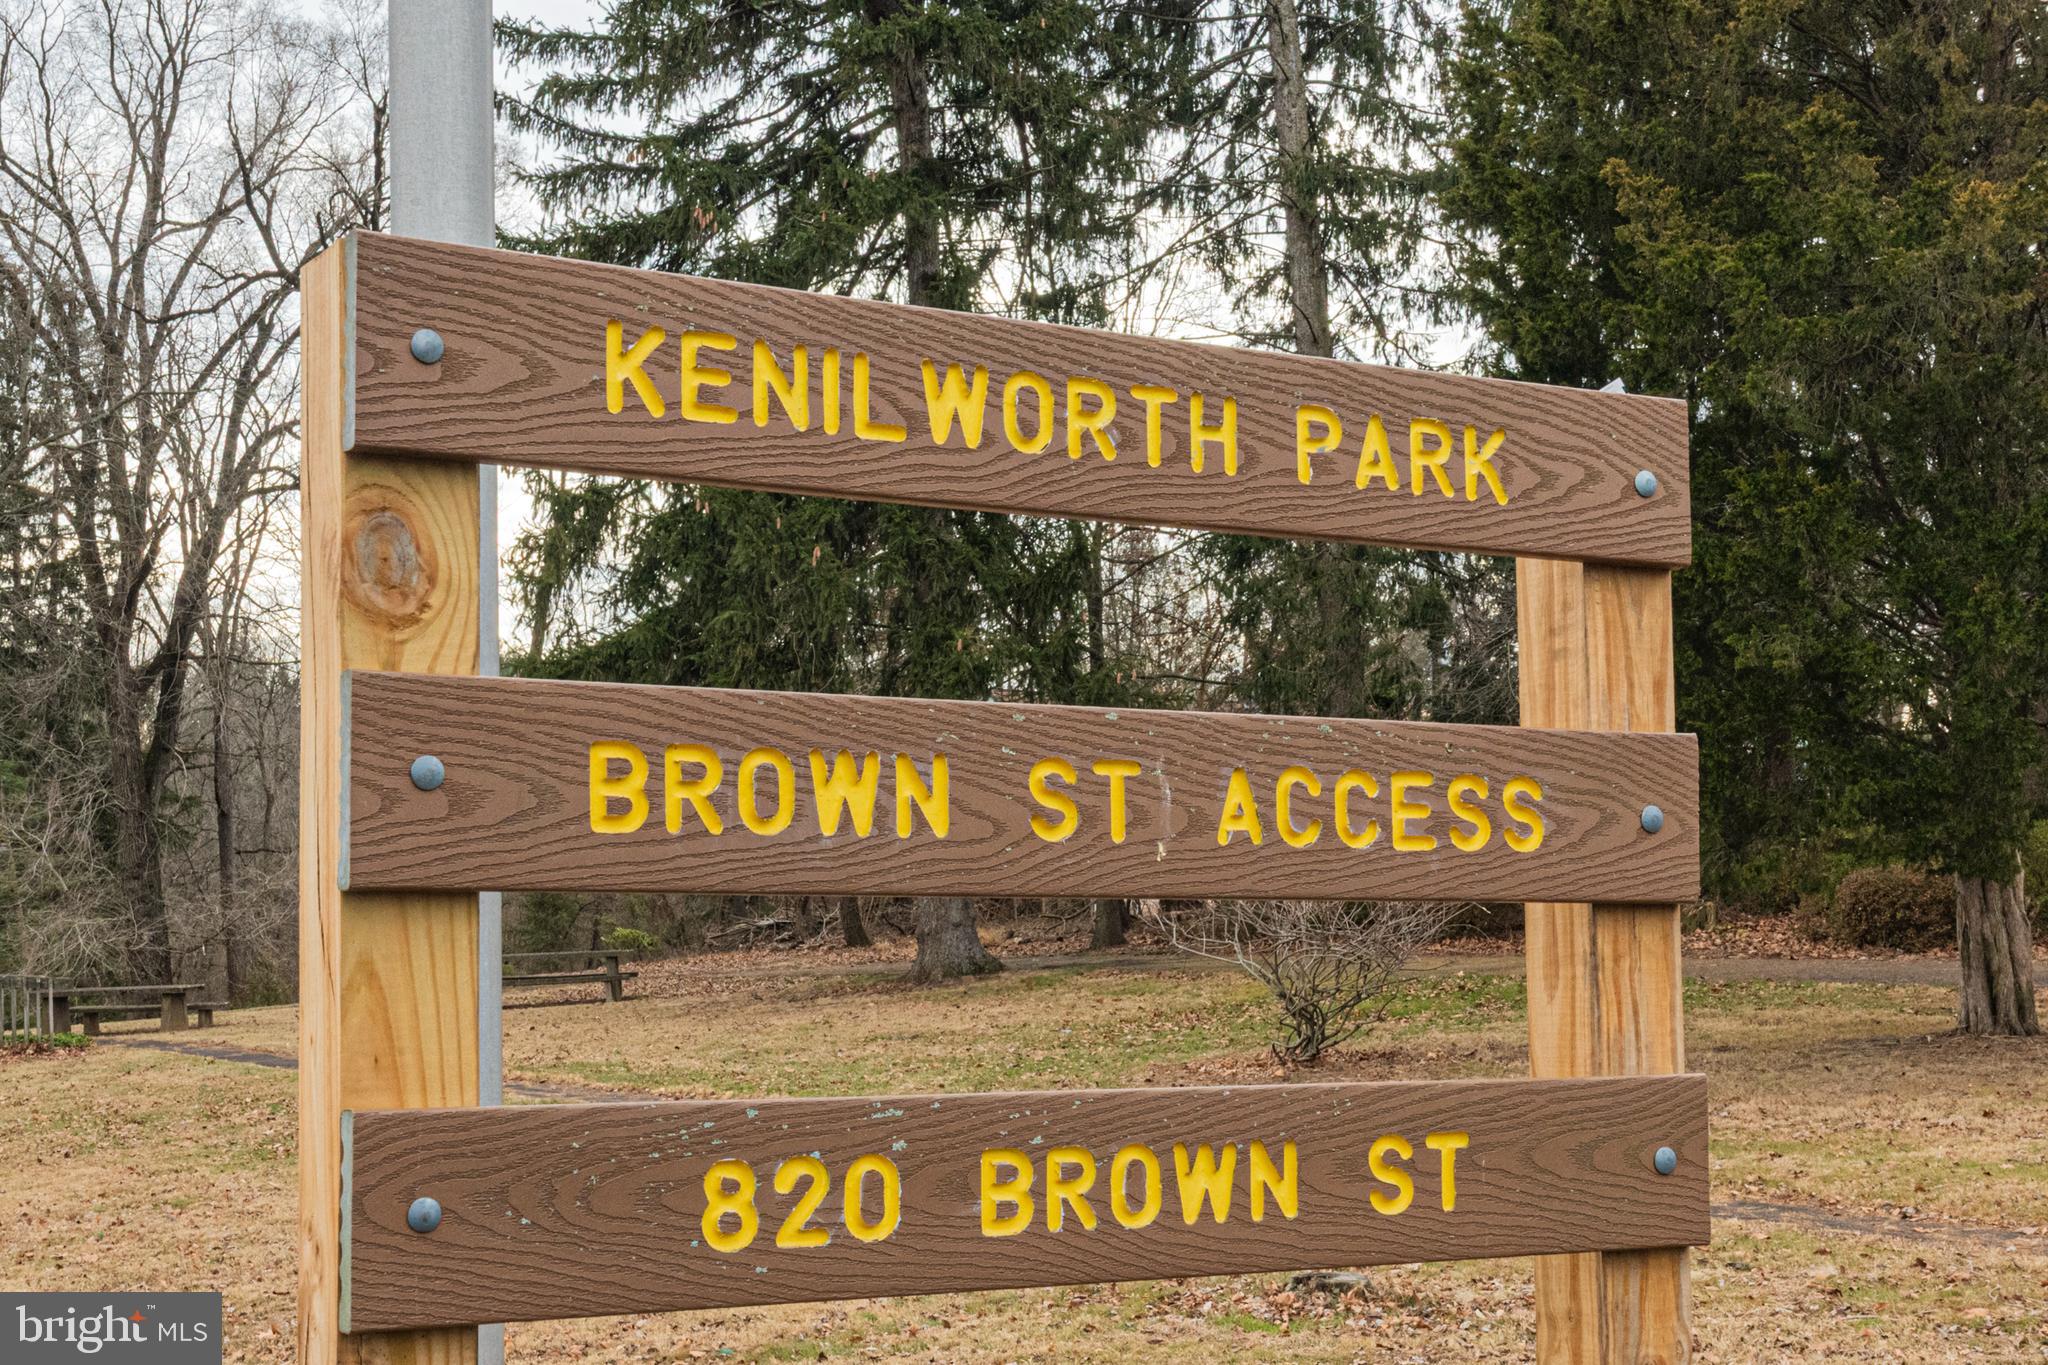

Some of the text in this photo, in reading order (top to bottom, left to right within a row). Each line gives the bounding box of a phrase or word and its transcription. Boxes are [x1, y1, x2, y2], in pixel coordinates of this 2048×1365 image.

[604, 320, 1509, 507] KENILWORTH PARK
[587, 741, 1546, 855] BROWN ST ACCESS
[701, 1131, 1472, 1253] 820 BROWN ST
